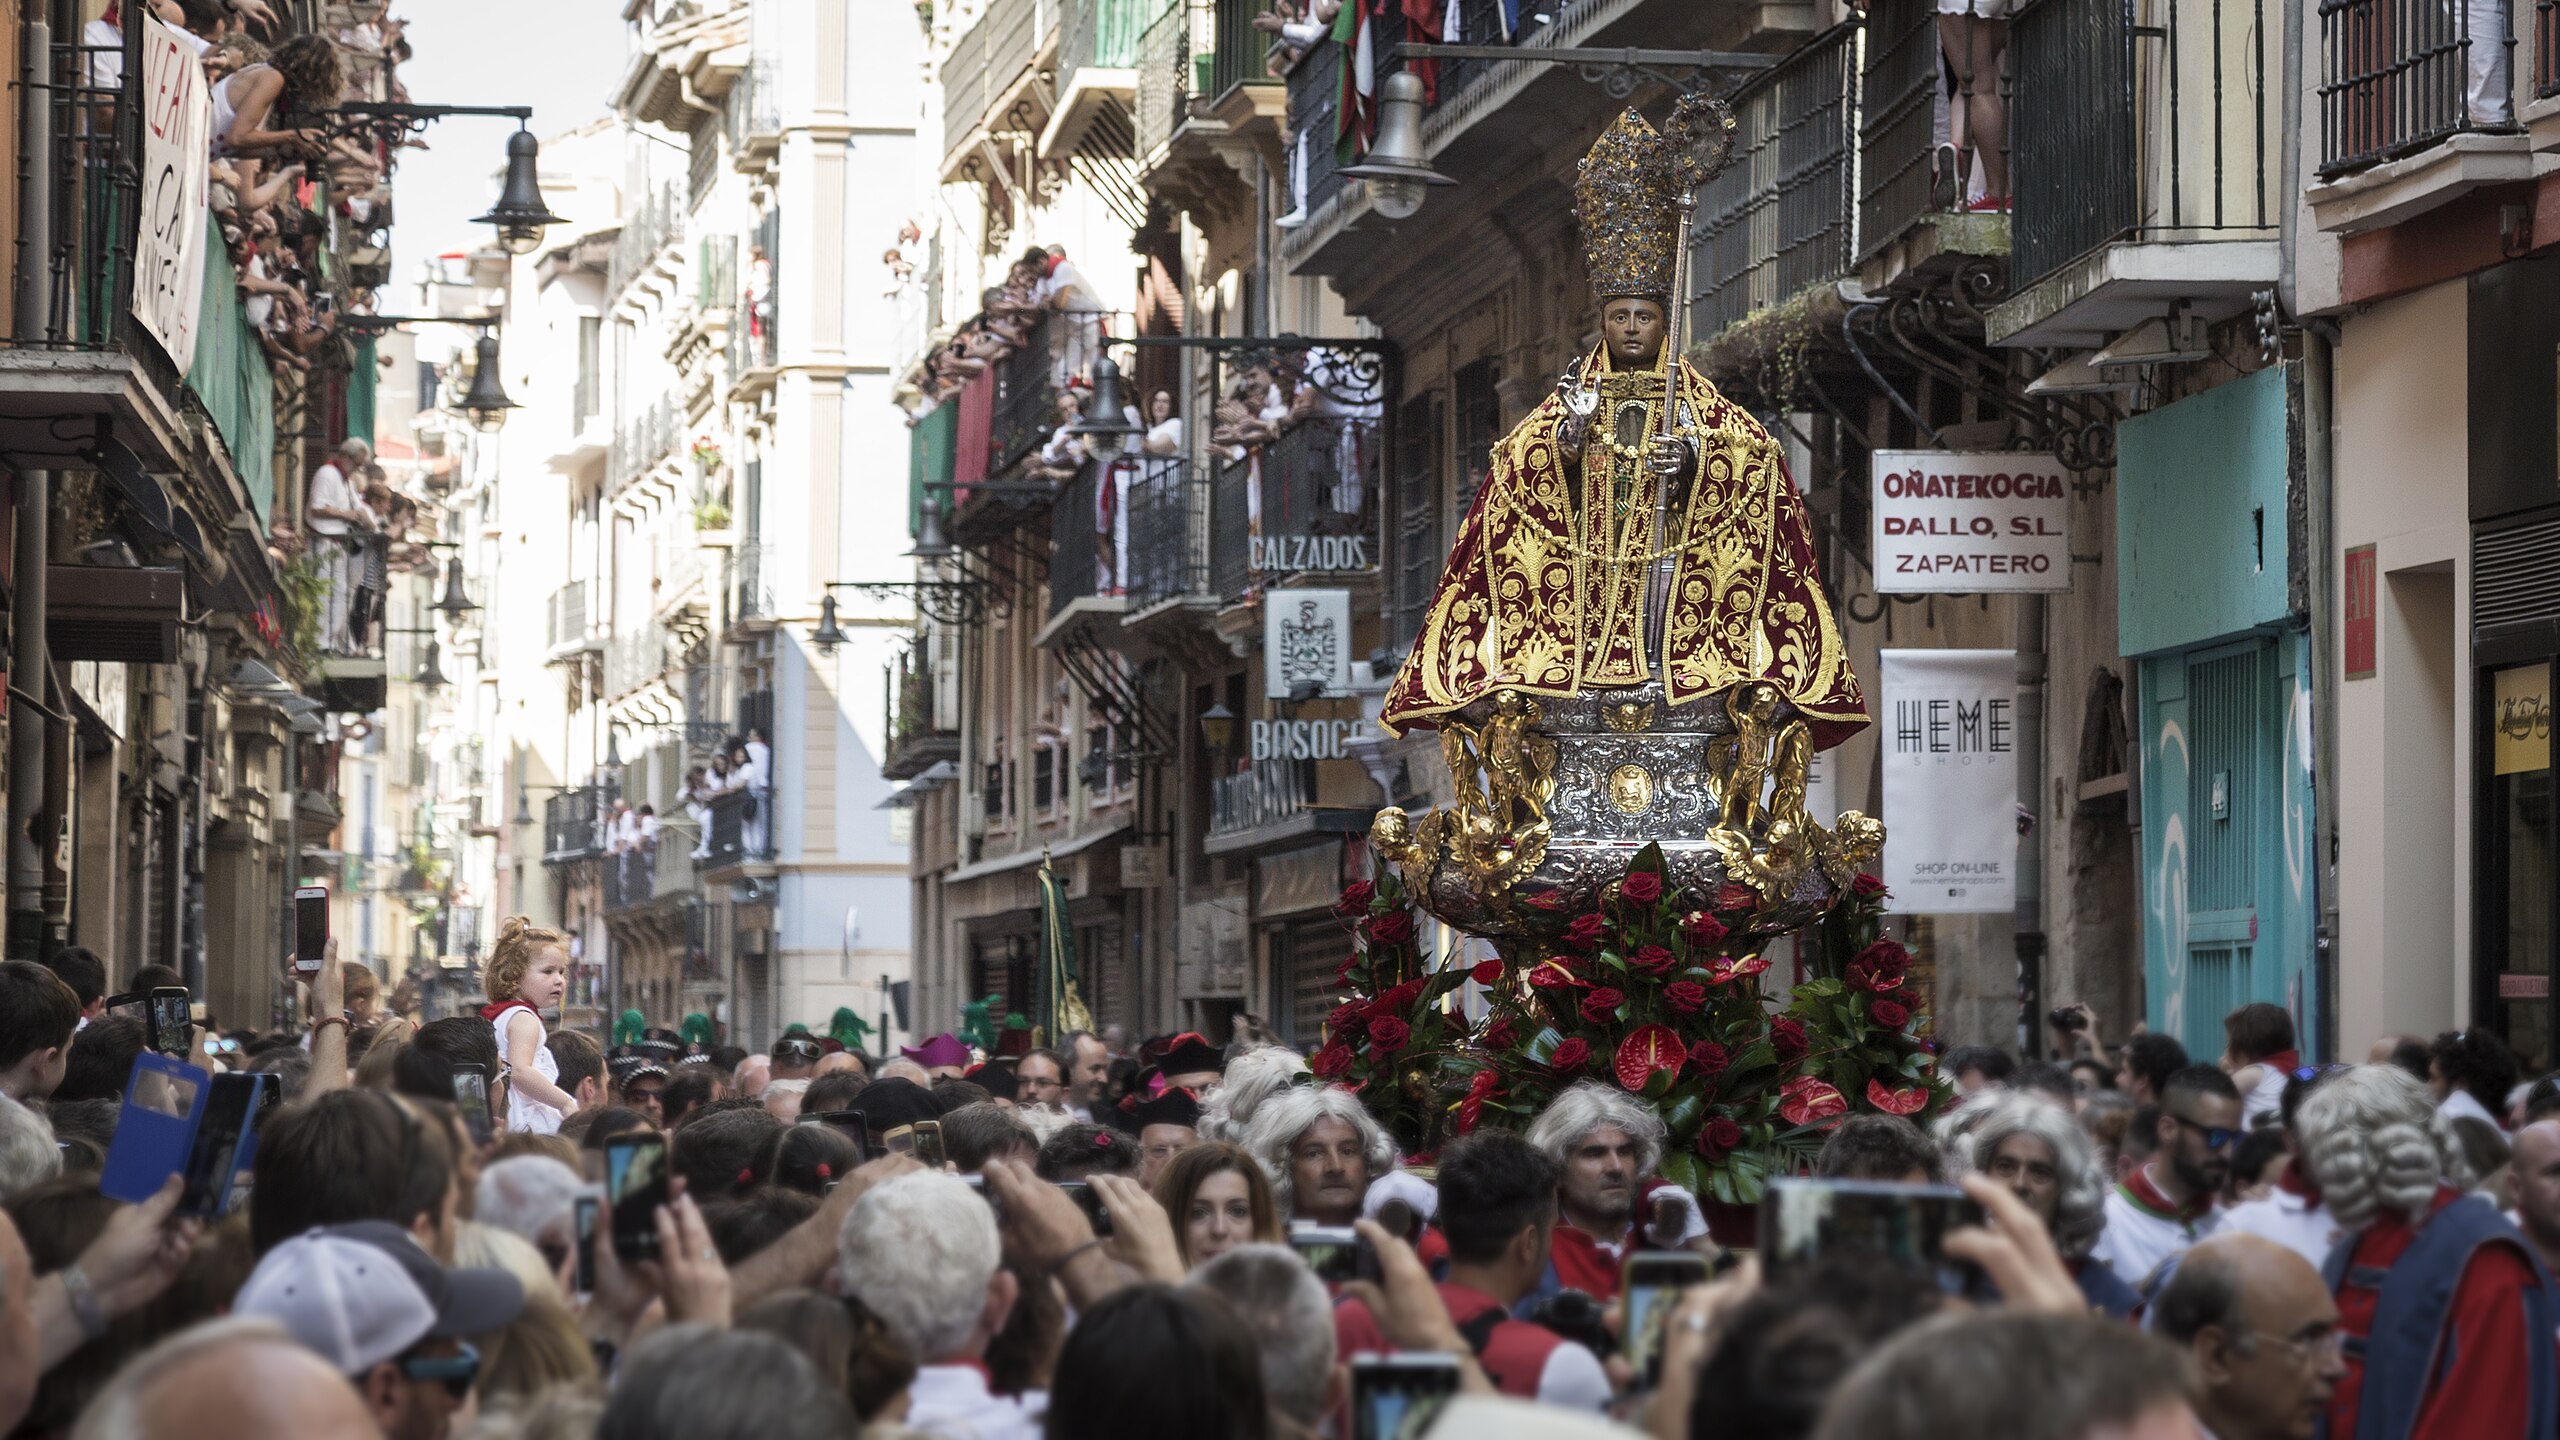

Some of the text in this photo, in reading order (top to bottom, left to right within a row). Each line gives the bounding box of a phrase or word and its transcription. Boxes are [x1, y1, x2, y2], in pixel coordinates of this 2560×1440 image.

[1883, 469, 2065, 499] OÑATEKOGIA
[1884, 517, 1998, 540] DALLO,
[1250, 535, 1367, 570] CALZADOS
[1896, 553, 2050, 574] ZAPATERO
[1897, 699, 2012, 753] HEME
[1913, 756, 1996, 766] SHOP
[1914, 863, 2001, 875] SHOP ON-LINE
